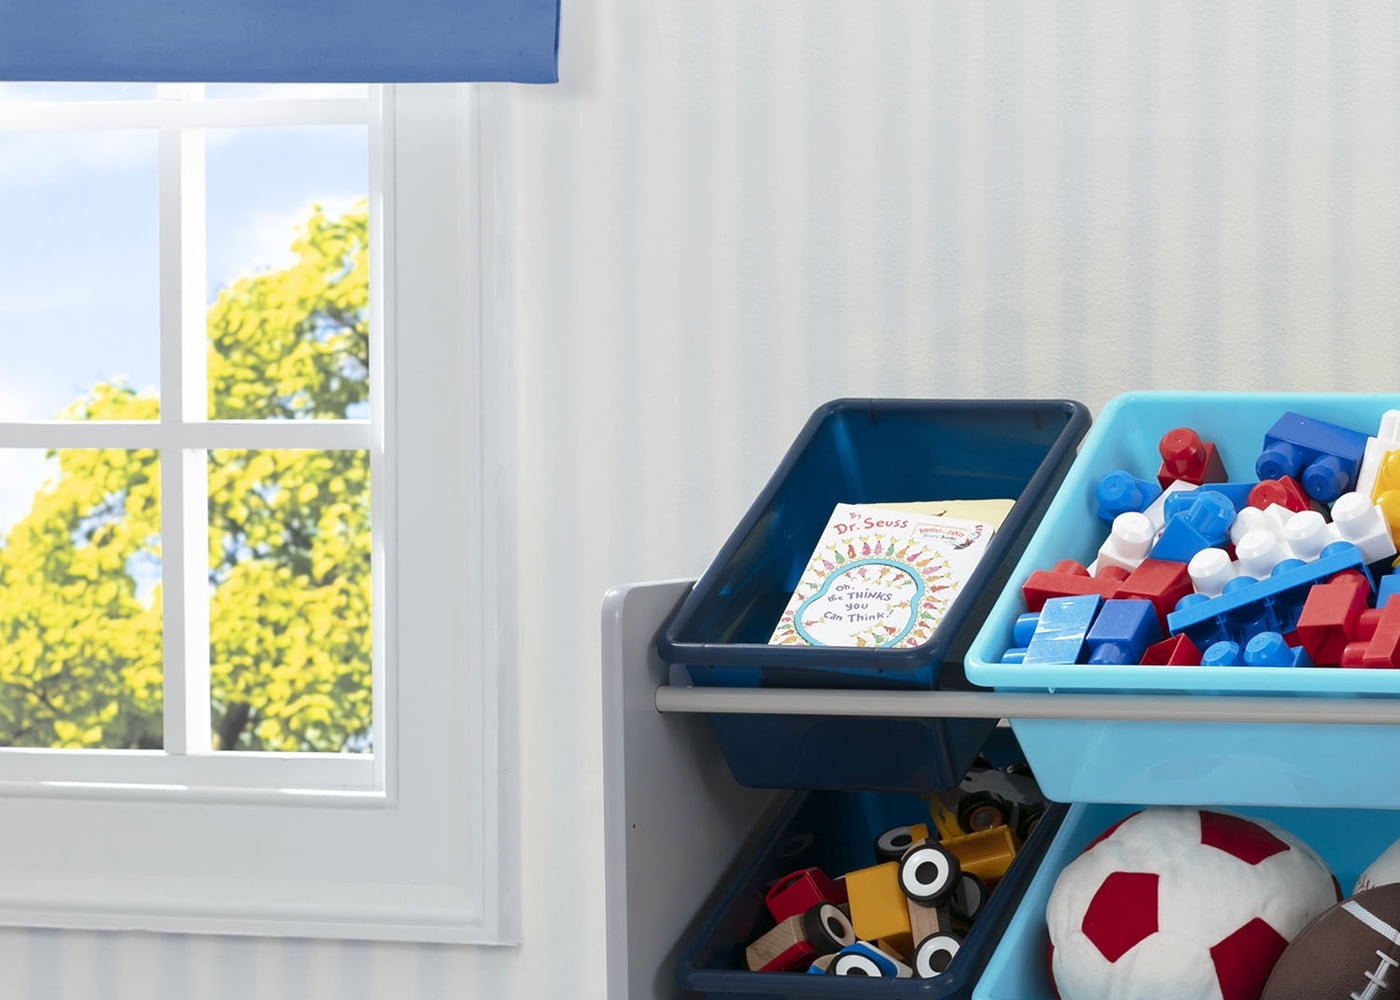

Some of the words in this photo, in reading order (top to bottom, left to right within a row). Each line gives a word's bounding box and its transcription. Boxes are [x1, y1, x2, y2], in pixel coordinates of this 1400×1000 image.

[850, 512, 862, 520] By
[833, 522, 861, 535] Dr.
[863, 518, 909, 529] Seuss
[828, 594, 843, 602] the
[845, 603, 869, 611] you
[848, 609, 894, 623] Think!
